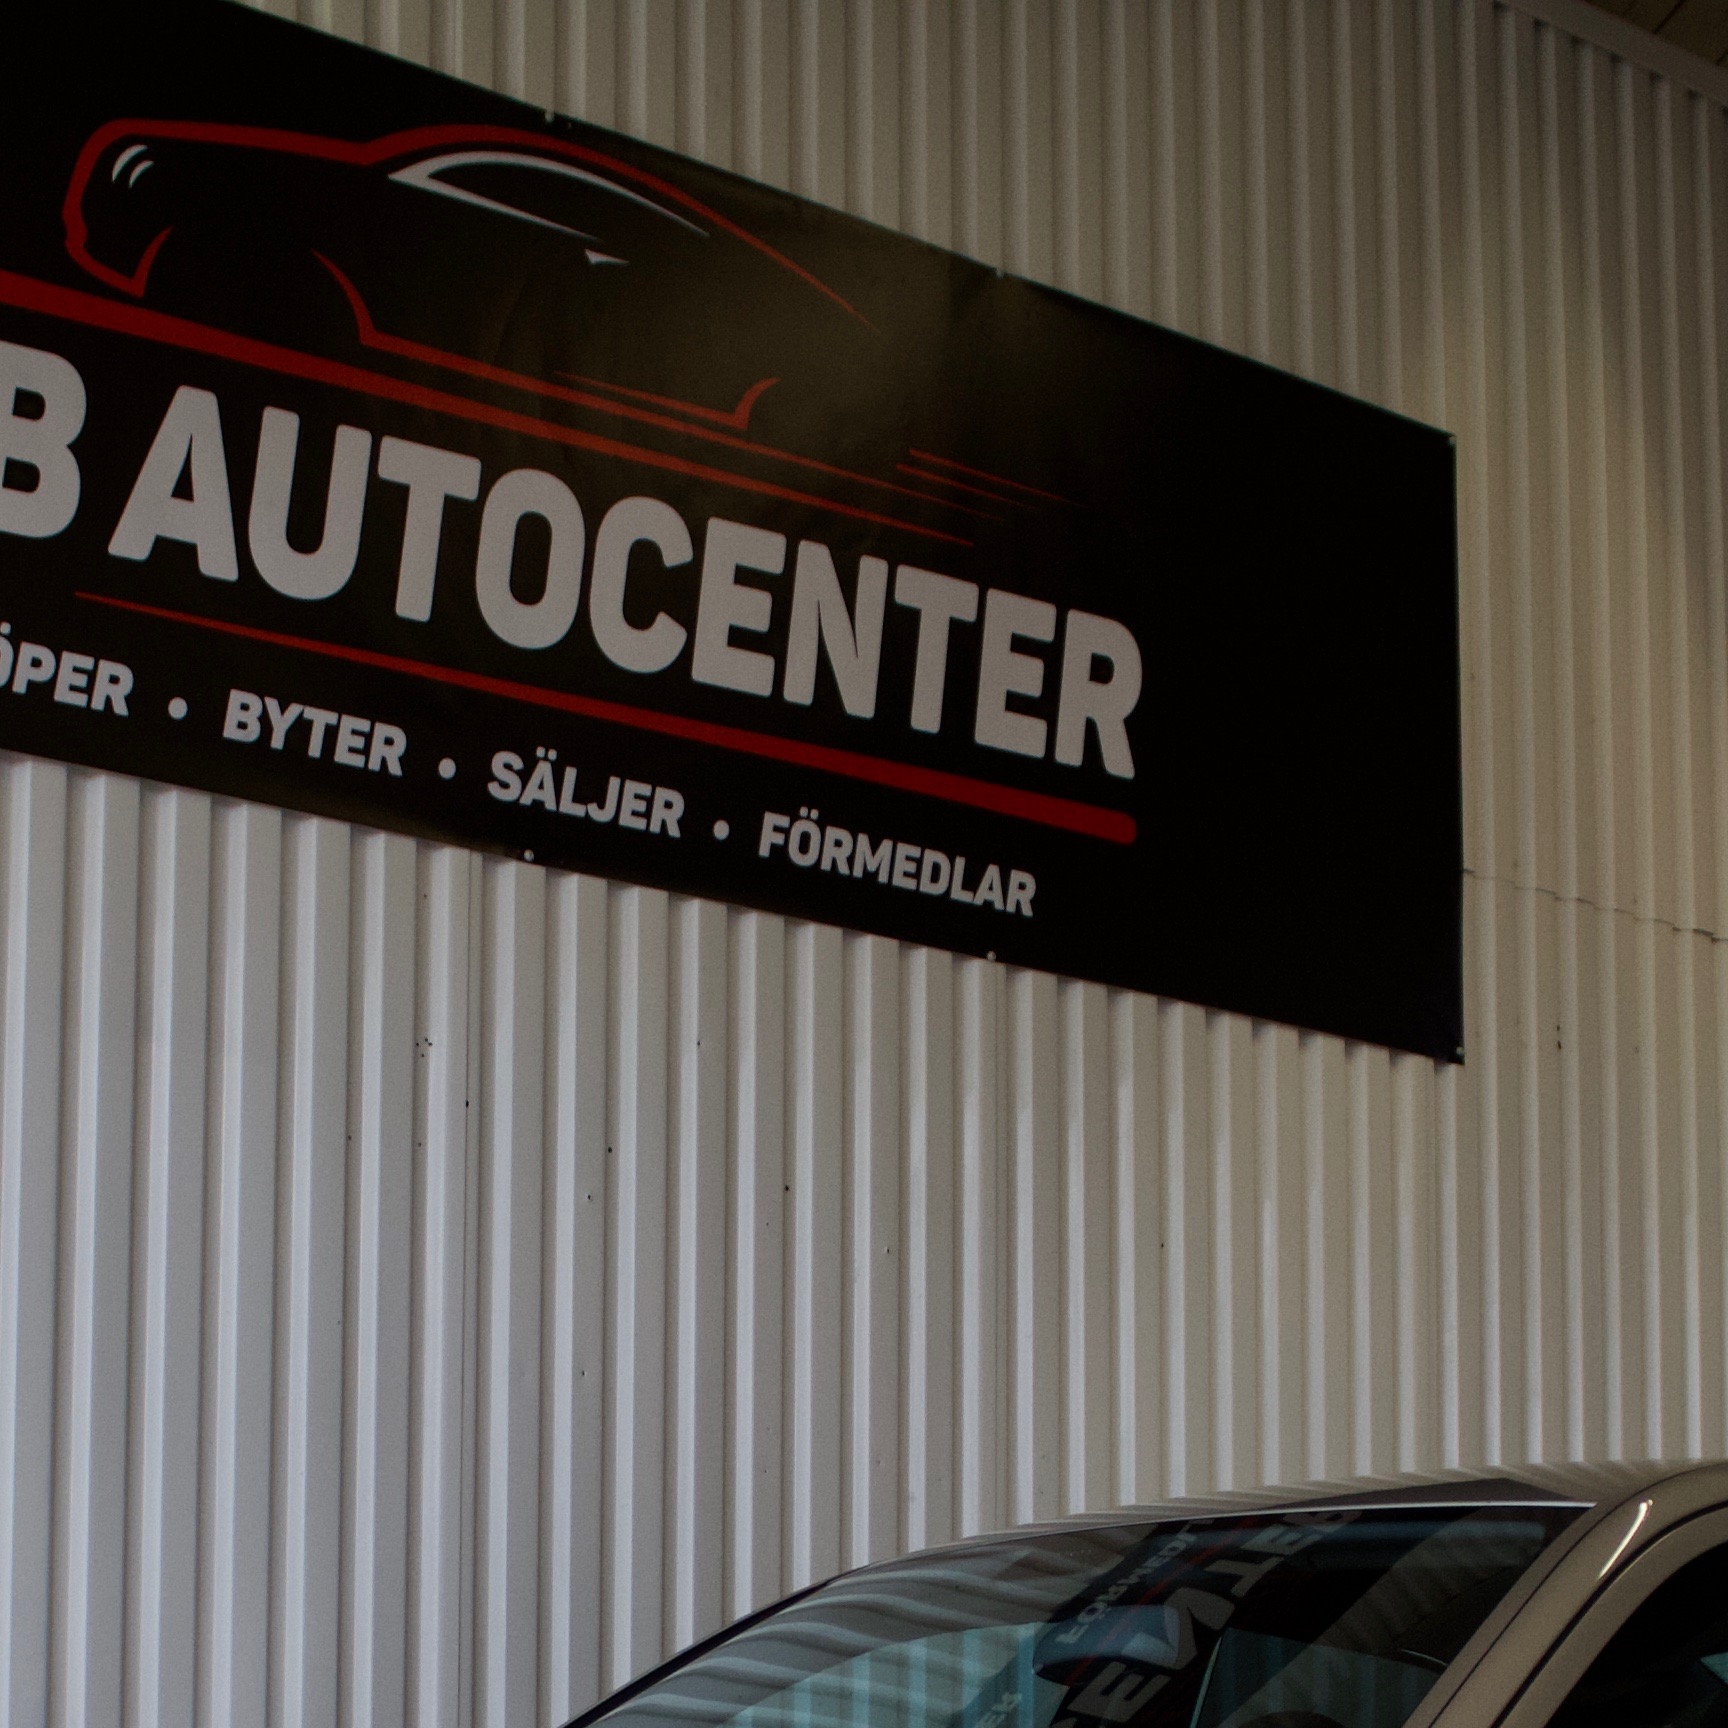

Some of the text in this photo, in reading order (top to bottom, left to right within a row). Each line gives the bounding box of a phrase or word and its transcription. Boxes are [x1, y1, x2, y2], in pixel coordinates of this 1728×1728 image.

[107, 385, 1142, 780] AUTOCENTER
[222, 688, 407, 777] BYTER
[487, 749, 685, 838] SÄLJER
[758, 811, 1037, 917] FÖRMEDLAR
